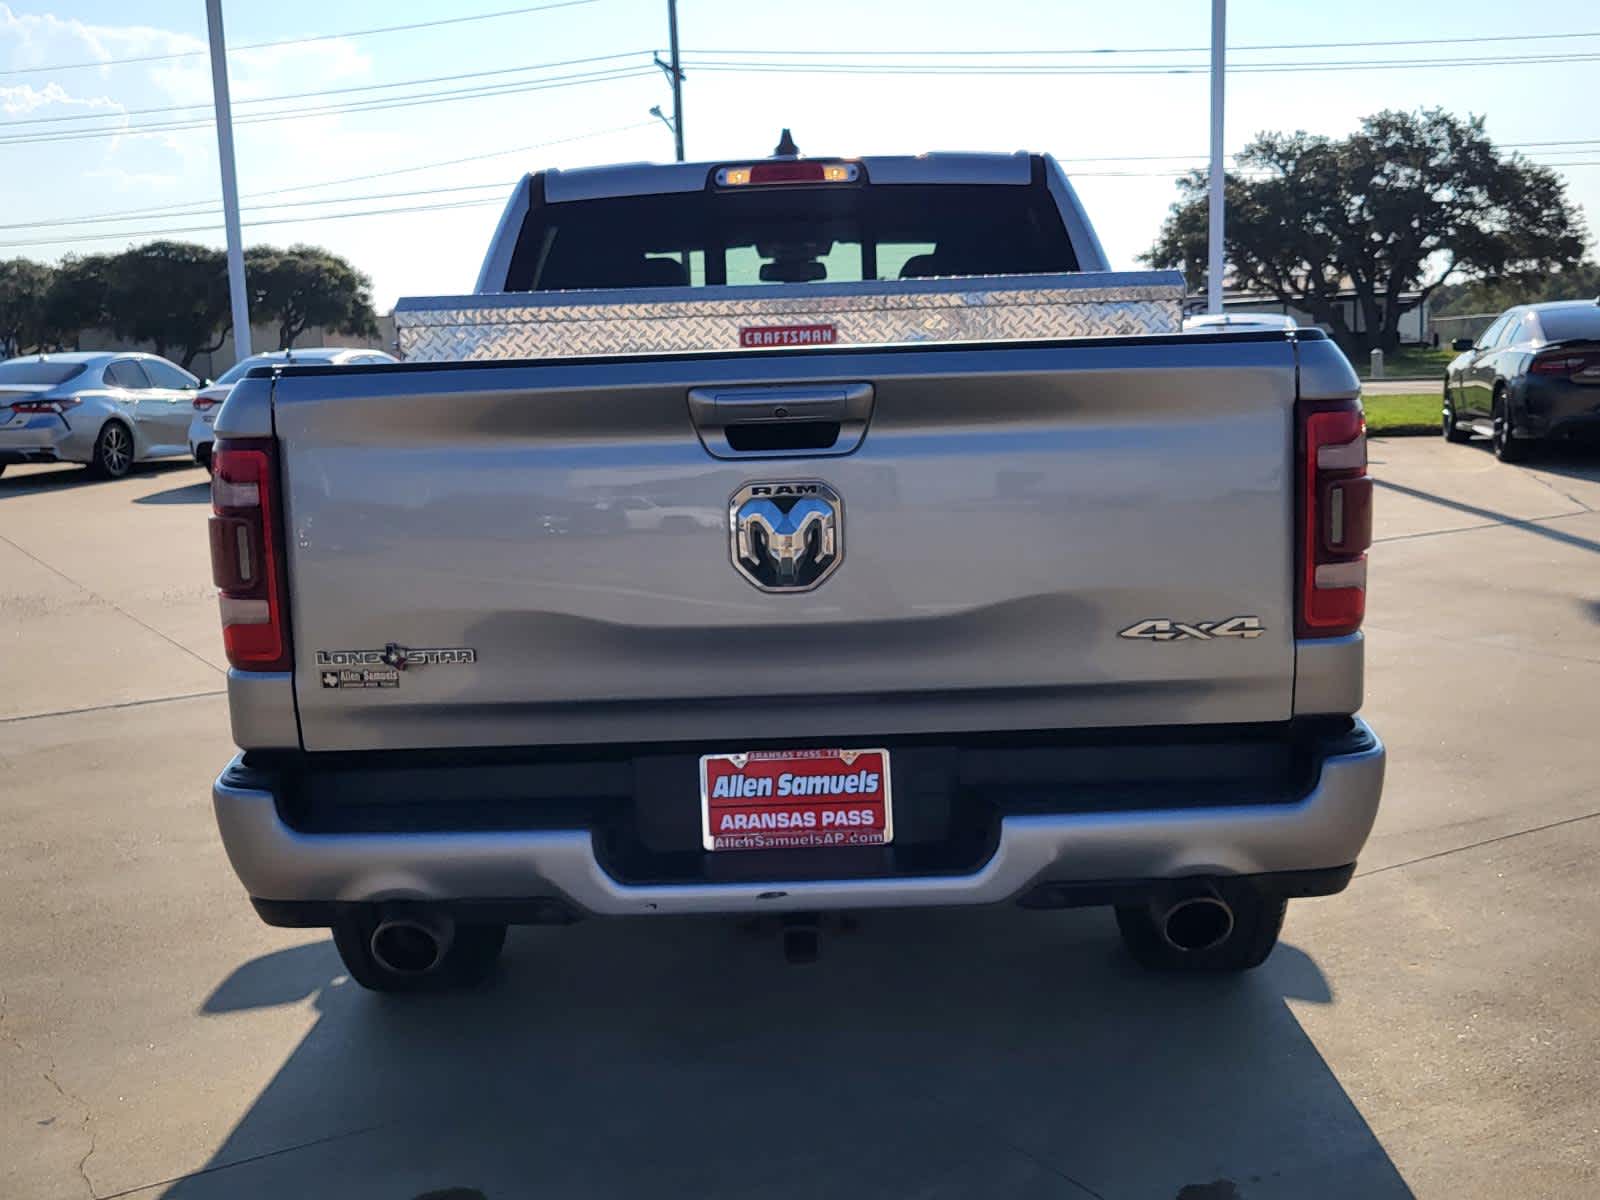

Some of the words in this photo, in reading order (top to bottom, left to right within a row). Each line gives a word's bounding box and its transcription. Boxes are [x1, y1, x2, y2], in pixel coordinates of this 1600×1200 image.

[744, 329, 832, 345] CRAFTSMAN
[751, 484, 818, 496] RAM
[316, 650, 382, 665] LONE
[406, 649, 477, 664] STAR
[712, 773, 773, 798] Allen
[777, 770, 879, 797] Samuels
[720, 812, 816, 830] ARANSAS
[822, 809, 874, 826] PASS
